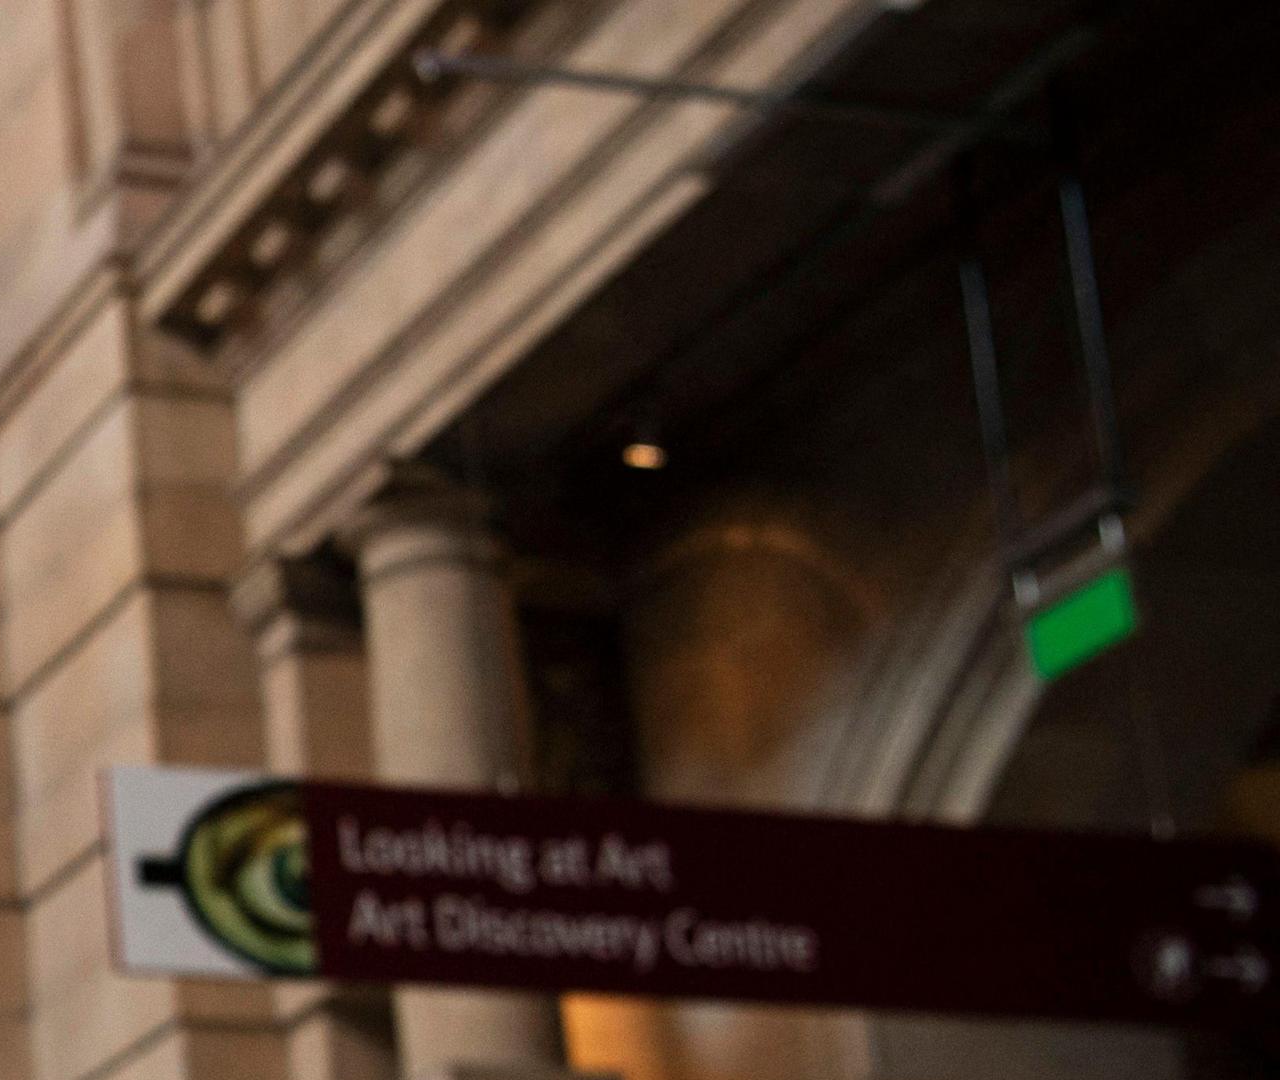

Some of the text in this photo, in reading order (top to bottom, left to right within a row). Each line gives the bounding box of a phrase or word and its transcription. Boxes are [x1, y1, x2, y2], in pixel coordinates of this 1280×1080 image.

[339, 817, 673, 893] Looking at Art
[349, 890, 818, 972] Art Discovery Centre
